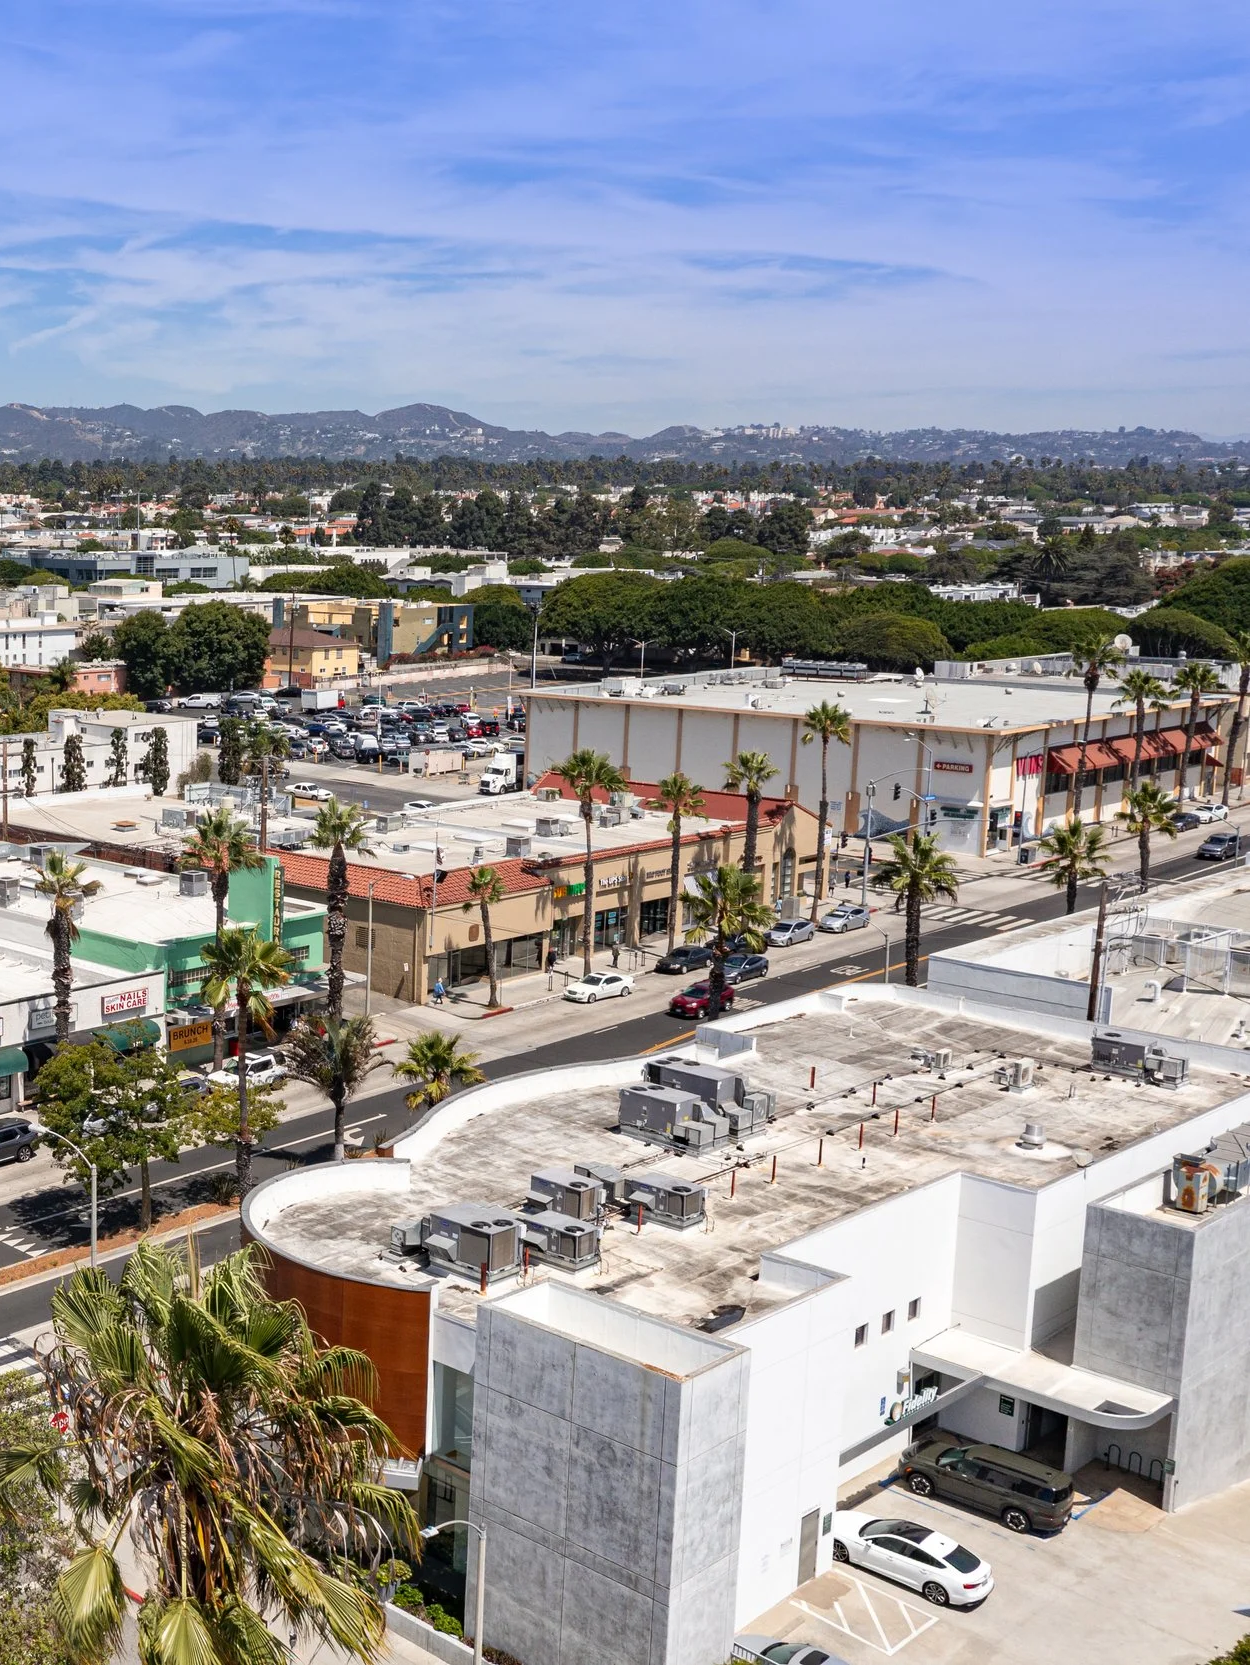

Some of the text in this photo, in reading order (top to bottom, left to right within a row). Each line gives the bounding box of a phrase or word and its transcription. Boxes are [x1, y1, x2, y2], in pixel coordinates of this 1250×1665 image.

[941, 764, 970, 773] PARKING
[120, 989, 147, 1002] NAILS
[105, 1003, 124, 1013] SKIN
[126, 998, 147, 1008] CARE
[173, 1025, 209, 1041] BRUNCH
[902, 1385, 939, 1416] Fidelity
[50, 1416, 69, 1429] STOP
